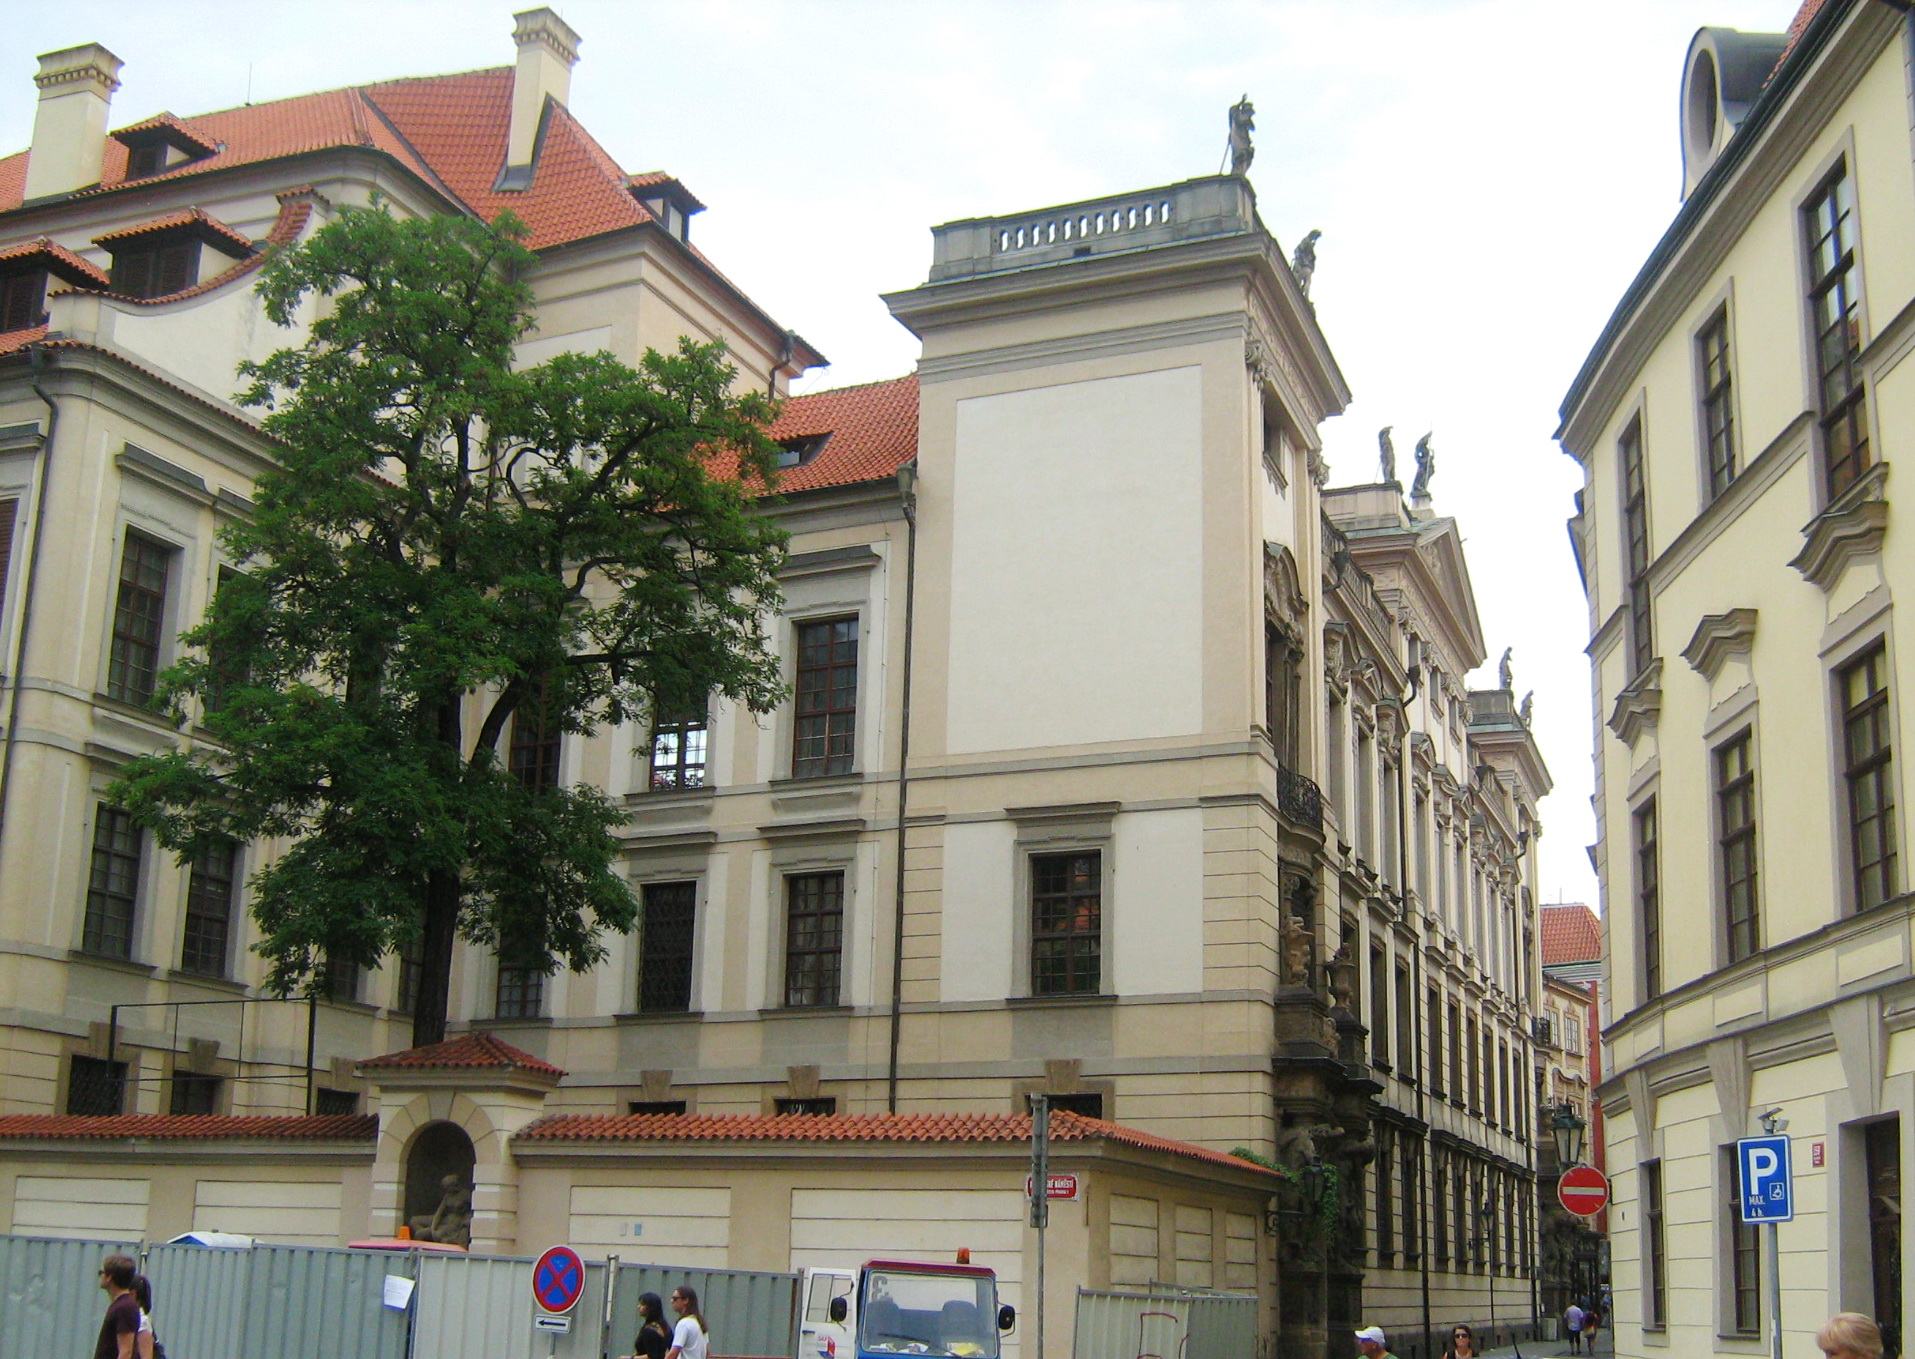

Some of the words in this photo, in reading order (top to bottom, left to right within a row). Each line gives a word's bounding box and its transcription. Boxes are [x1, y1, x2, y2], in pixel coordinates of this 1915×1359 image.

[1748, 1148, 1778, 1195] P
[1749, 1195, 1766, 1205] MAX.
[1751, 1207, 1757, 1217] 4
